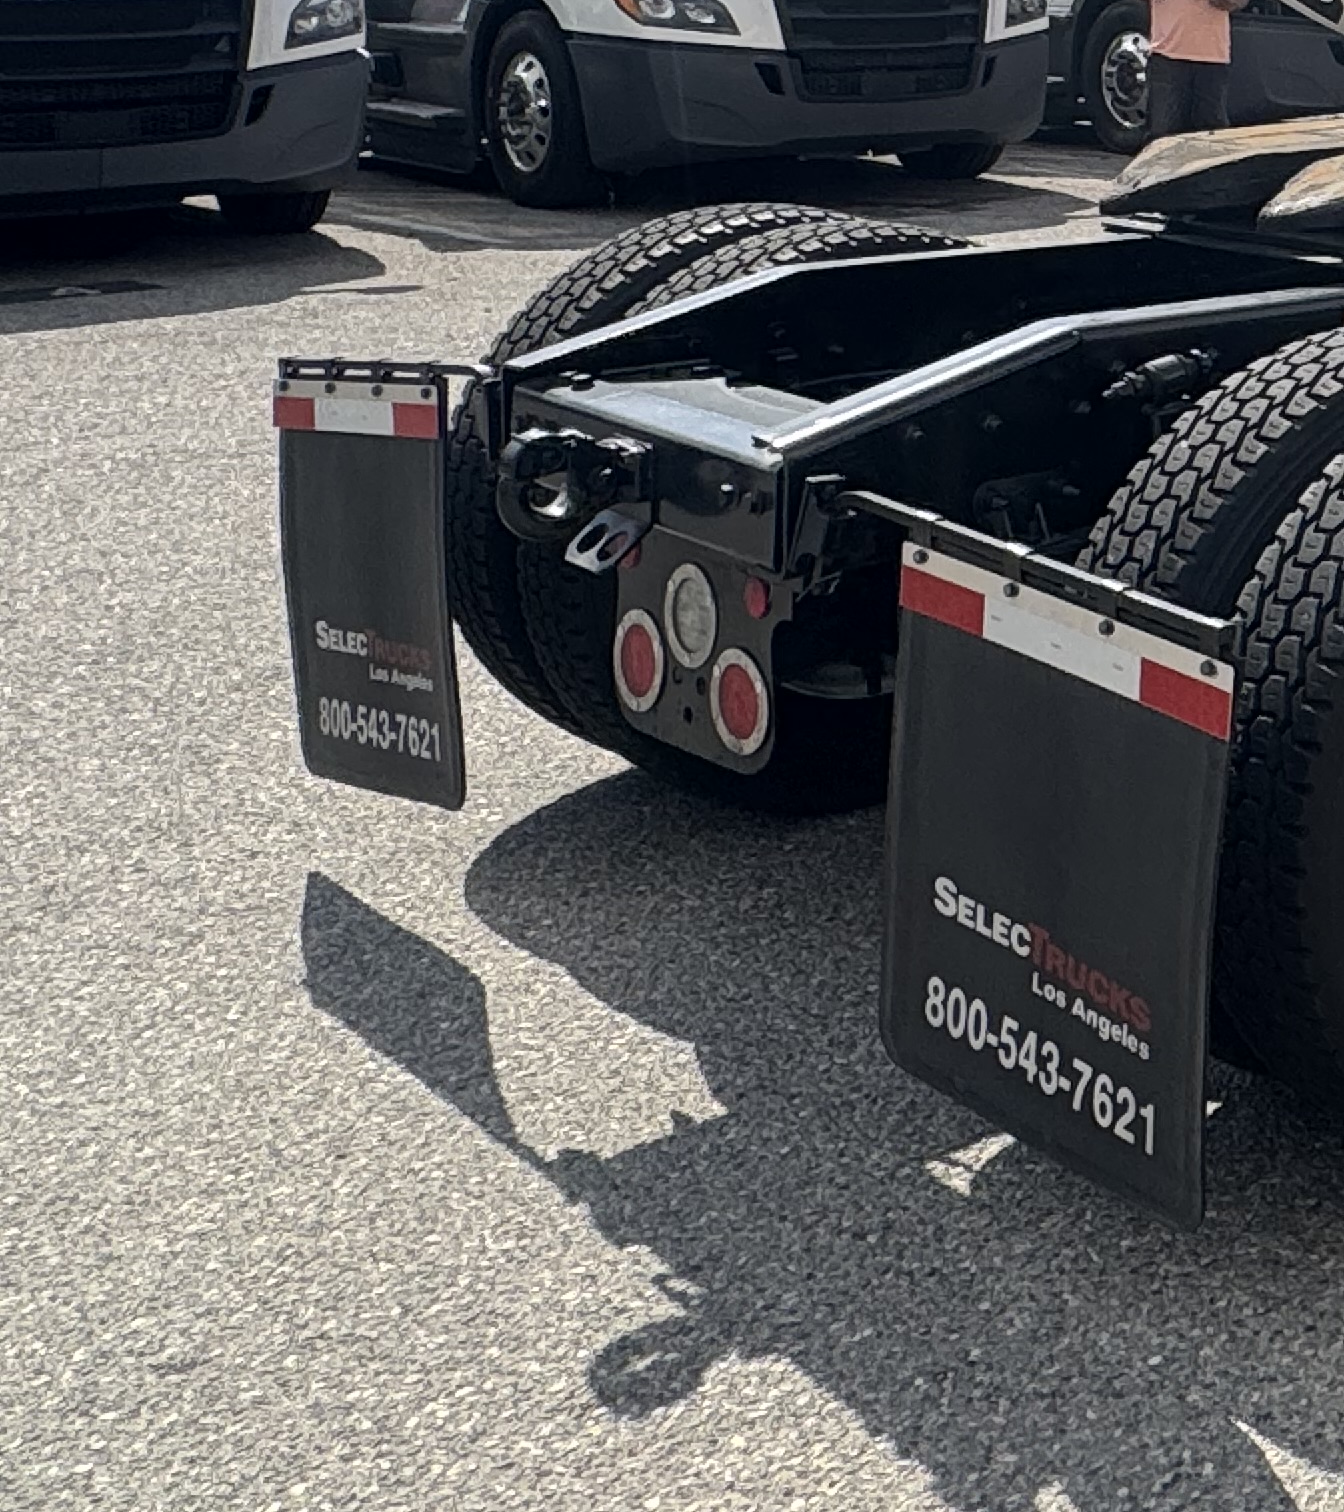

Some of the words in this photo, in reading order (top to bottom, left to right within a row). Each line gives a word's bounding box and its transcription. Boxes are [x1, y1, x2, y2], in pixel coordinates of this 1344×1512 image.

[315, 620, 433, 670] SELECTRUCKS
[368, 662, 390, 682] Los
[390, 668, 433, 692] Angeles
[319, 696, 441, 762] 800-543-7621
[933, 875, 1151, 1032] SELECTRUCKS
[1031, 970, 1067, 1009] Los
[1070, 996, 1150, 1061] Angeles
[925, 975, 1155, 1156] 800-543-7621
